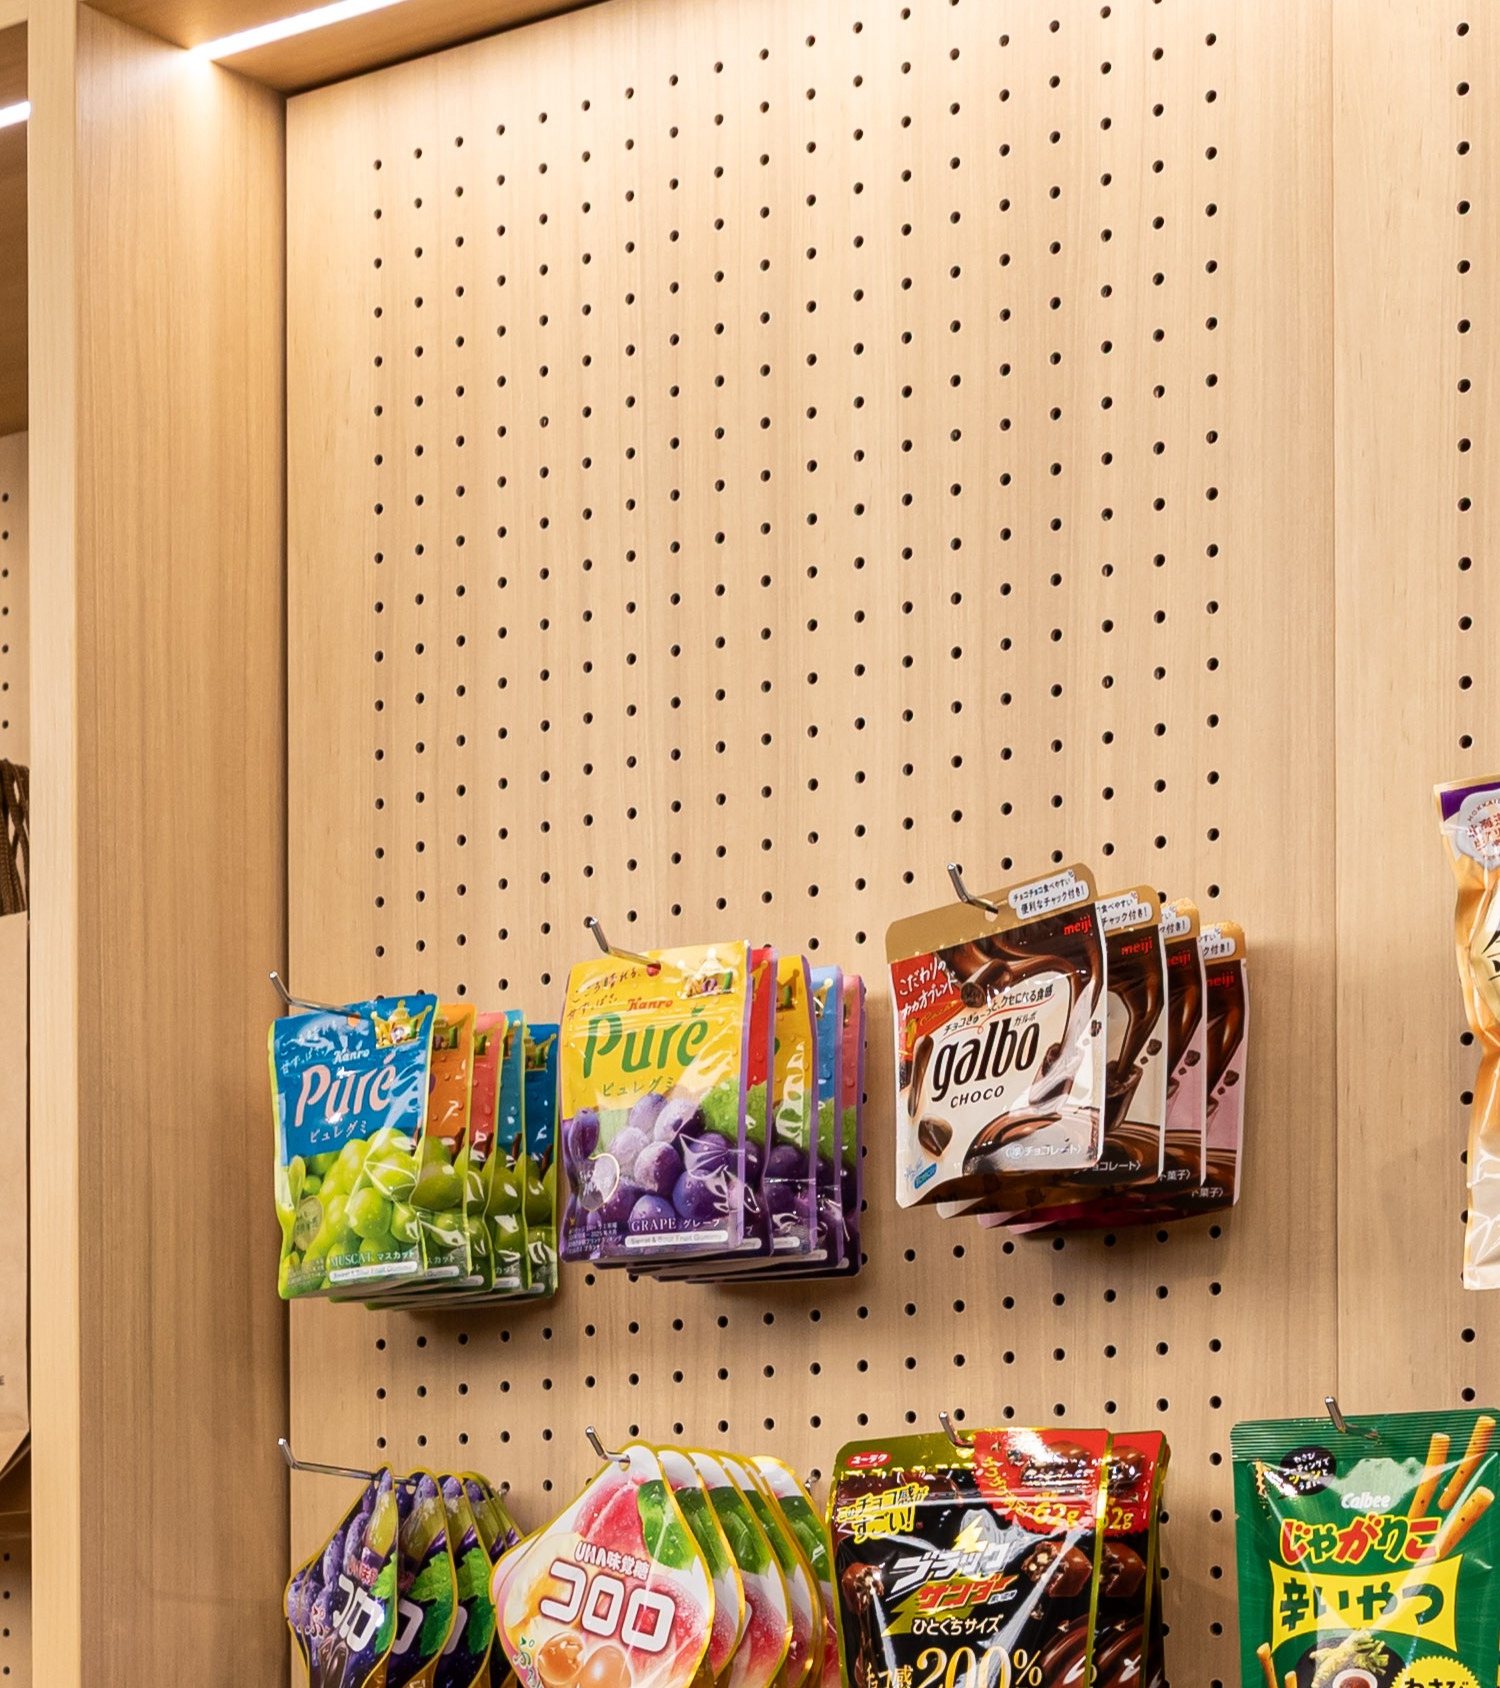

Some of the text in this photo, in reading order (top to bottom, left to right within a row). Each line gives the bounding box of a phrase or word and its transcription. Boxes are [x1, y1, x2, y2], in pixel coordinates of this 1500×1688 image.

[1063, 914, 1092, 935] meiji
[1121, 936, 1153, 956] meiji
[900, 961, 946, 996] こだわりの
[628, 997, 673, 1011] Kanro
[583, 1004, 708, 1078] Puré
[931, 1017, 1041, 1102] galbo
[602, 1076, 675, 1097] ピュレグミ
[950, 1085, 1005, 1109] CHOCO
[309, 1120, 367, 1143] ピュレグミ
[631, 1217, 676, 1232] GRAPE
[683, 1217, 720, 1229] グレープ
[330, 1250, 372, 1267] MUSCAT
[376, 1248, 415, 1261] マスカット
[851, 1452, 888, 1465] ユーラク
[1341, 1493, 1390, 1509] Calbee
[1034, 1504, 1081, 1529] 62g
[1280, 1515, 1441, 1565] じゃがりこ
[575, 1541, 651, 1582] UHA味覚糖
[918, 1573, 1019, 1612] サンダー
[540, 1559, 676, 1653] コロロ
[1279, 1578, 1444, 1632] 辛いやつ
[912, 1614, 1003, 1636] ひとくちサイズ
